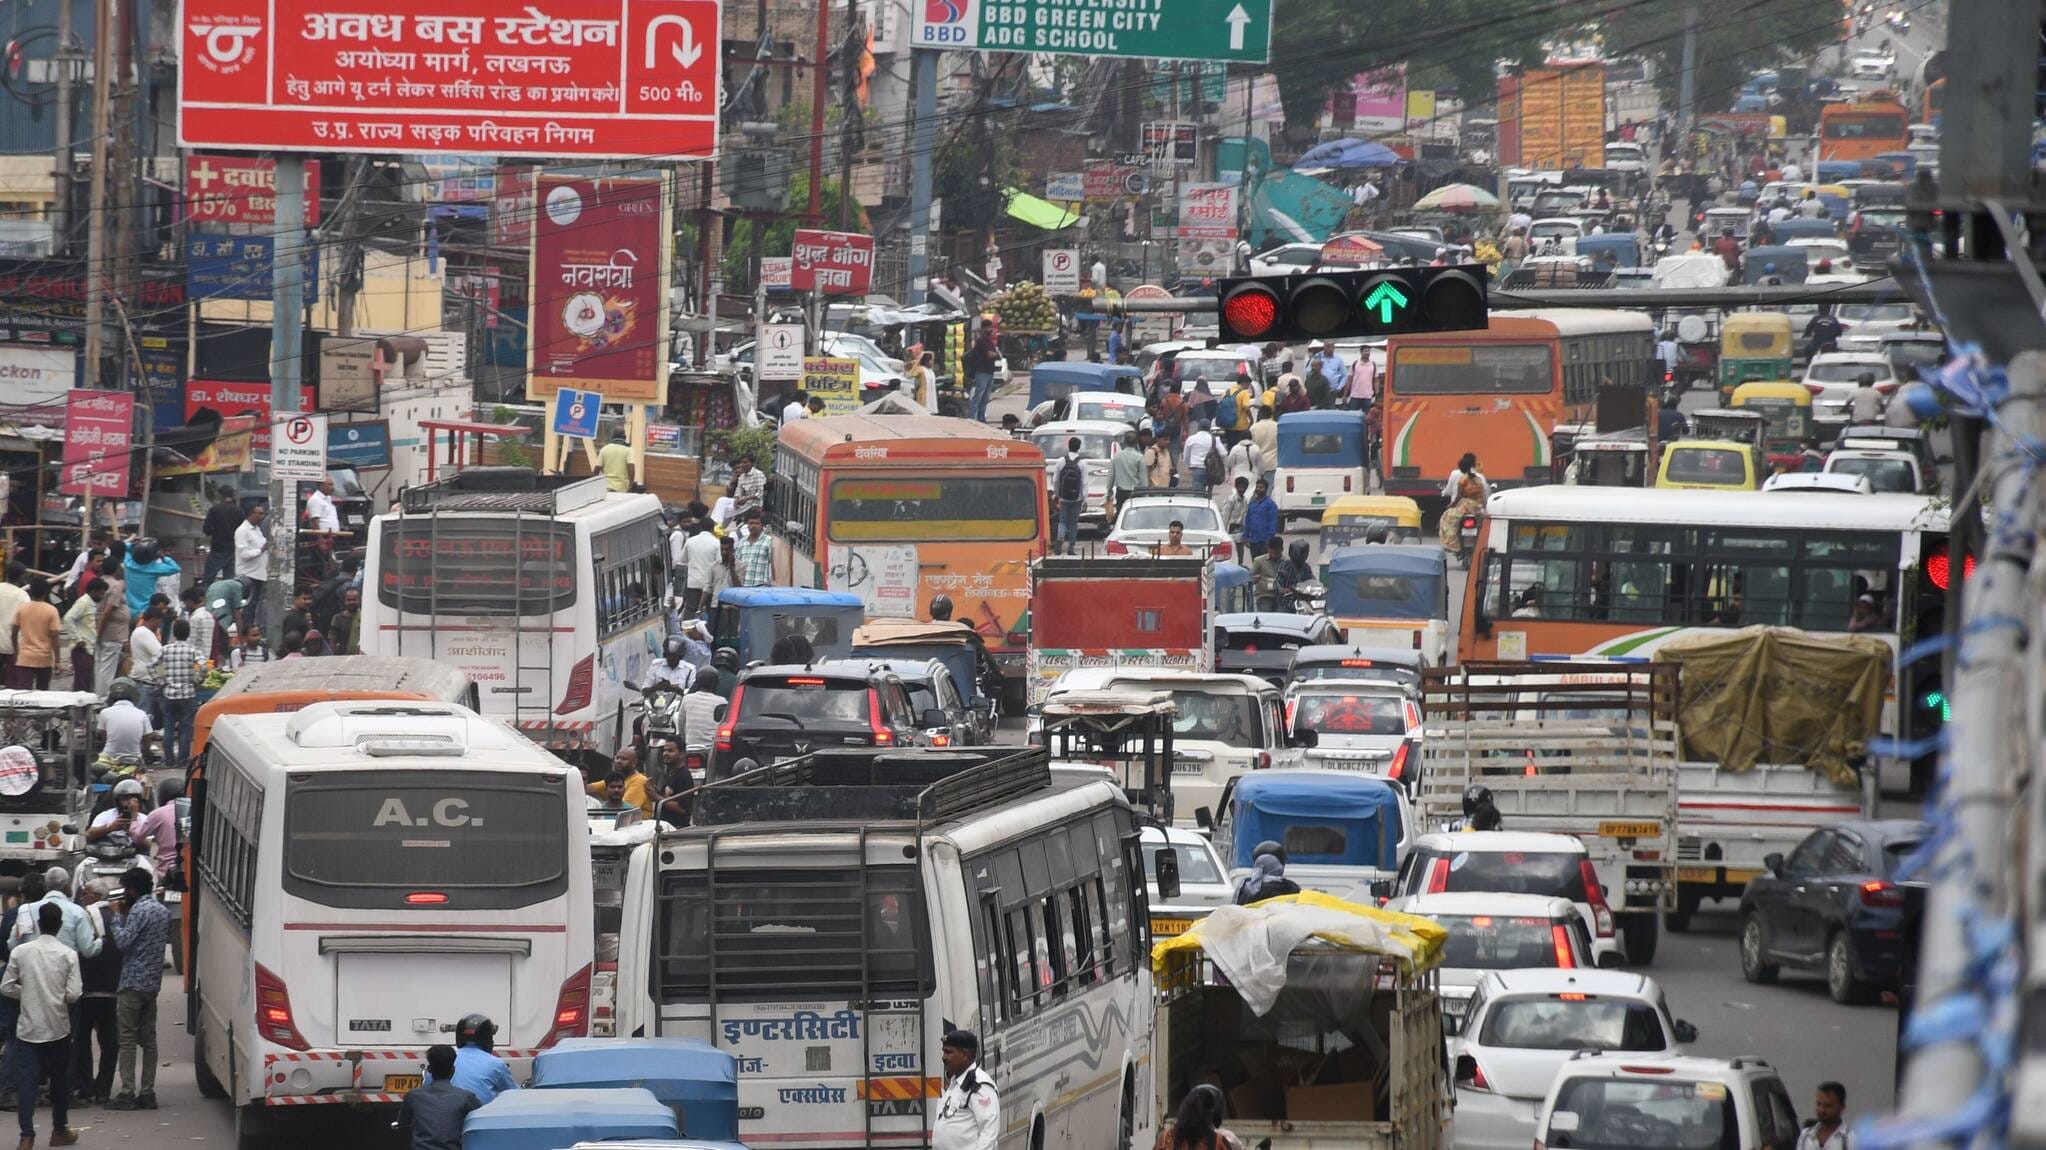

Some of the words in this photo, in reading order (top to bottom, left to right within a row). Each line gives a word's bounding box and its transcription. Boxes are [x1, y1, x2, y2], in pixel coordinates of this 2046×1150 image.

[301, 11, 406, 42] अवध
[415, 14, 484, 44] बस
[495, 5, 620, 47] स्टेशन
[985, 6, 1027, 25] BBD
[1035, 8, 1107, 29] GREEN
[1112, 11, 1162, 31] CITY
[924, 26, 966, 42] BBD
[984, 26, 1026, 46] ADG
[1035, 28, 1118, 50] SCHOOL
[335, 47, 416, 70] अयोध्या
[422, 47, 477, 74] मार्ग,
[484, 54, 571, 74] लखनऊ
[287, 74, 310, 100] हेतु
[313, 75, 346, 96] आगे
[350, 80, 365, 100] यू
[368, 80, 391, 96] टर्न
[397, 77, 434, 97] लेकर
[441, 79, 484, 100] सर्विस
[489, 80, 521, 101] रोड
[527, 84, 547, 101] का
[551, 81, 590, 102] प्रयोग
[640, 86, 670, 101] 500
[313, 121, 351, 140] उ.प्र.
[358, 122, 402, 140] राज्य
[410, 124, 460, 146] सड़क
[467, 121, 538, 141] परिवहन
[545, 122, 594, 144] निगम
[192, 191, 237, 216] 15%
[832, 242, 870, 267] भोग
[854, 447, 888, 459] देवरिया
[986, 445, 1009, 459] डिपो
[447, 645, 507, 657] आशीर्वाद
[1560, 674, 1644, 685] AMBULANE
[373, 798, 483, 827] A.C.
[351, 1020, 389, 1030] TATA
[721, 1010, 862, 1045] इण्टरसिटी
[872, 1053, 916, 1072] इटवा
[778, 1083, 847, 1104] एक्सप्रेस
